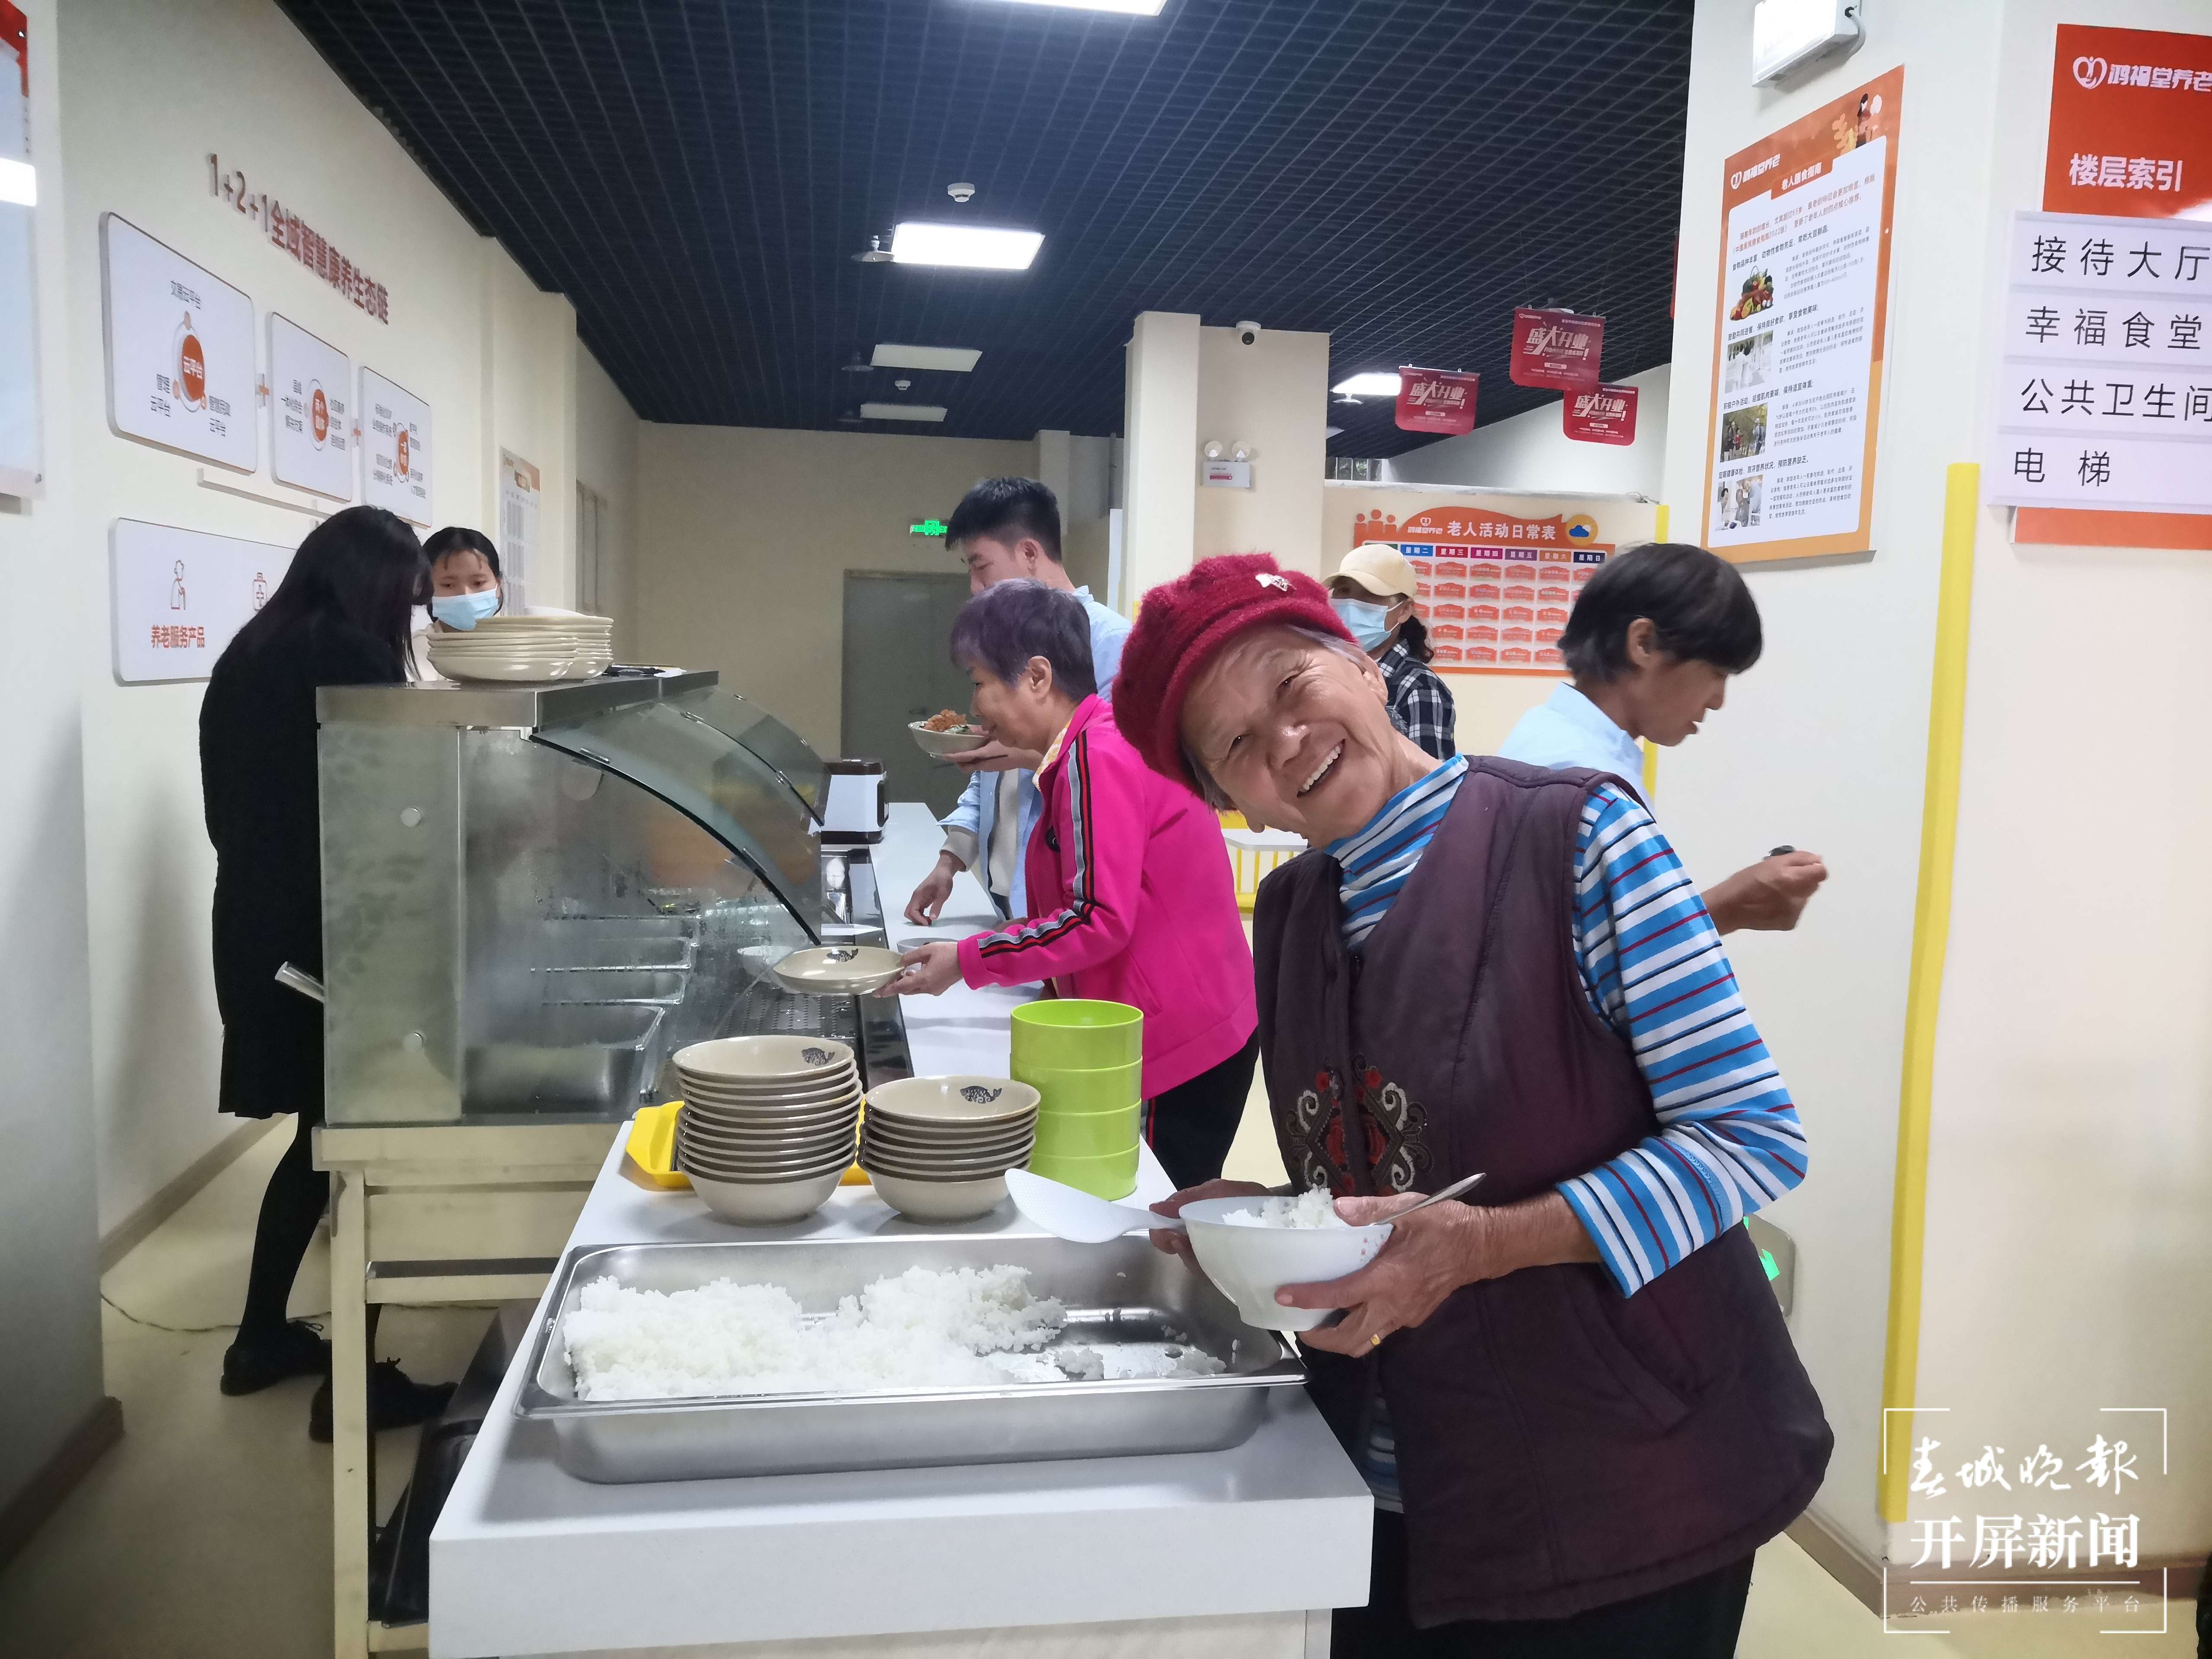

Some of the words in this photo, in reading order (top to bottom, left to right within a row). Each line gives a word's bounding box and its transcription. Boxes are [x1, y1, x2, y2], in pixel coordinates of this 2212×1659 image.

[2069, 153, 2183, 192] 楼层索引
[2031, 235, 2211, 281] 接待大厅
[2026, 306, 2202, 350] 幸福食堂
[2021, 378, 2212, 422] 公共卫生间
[2014, 447, 2111, 487] 电梯
[1447, 521, 1556, 540] 老人活动日常表
